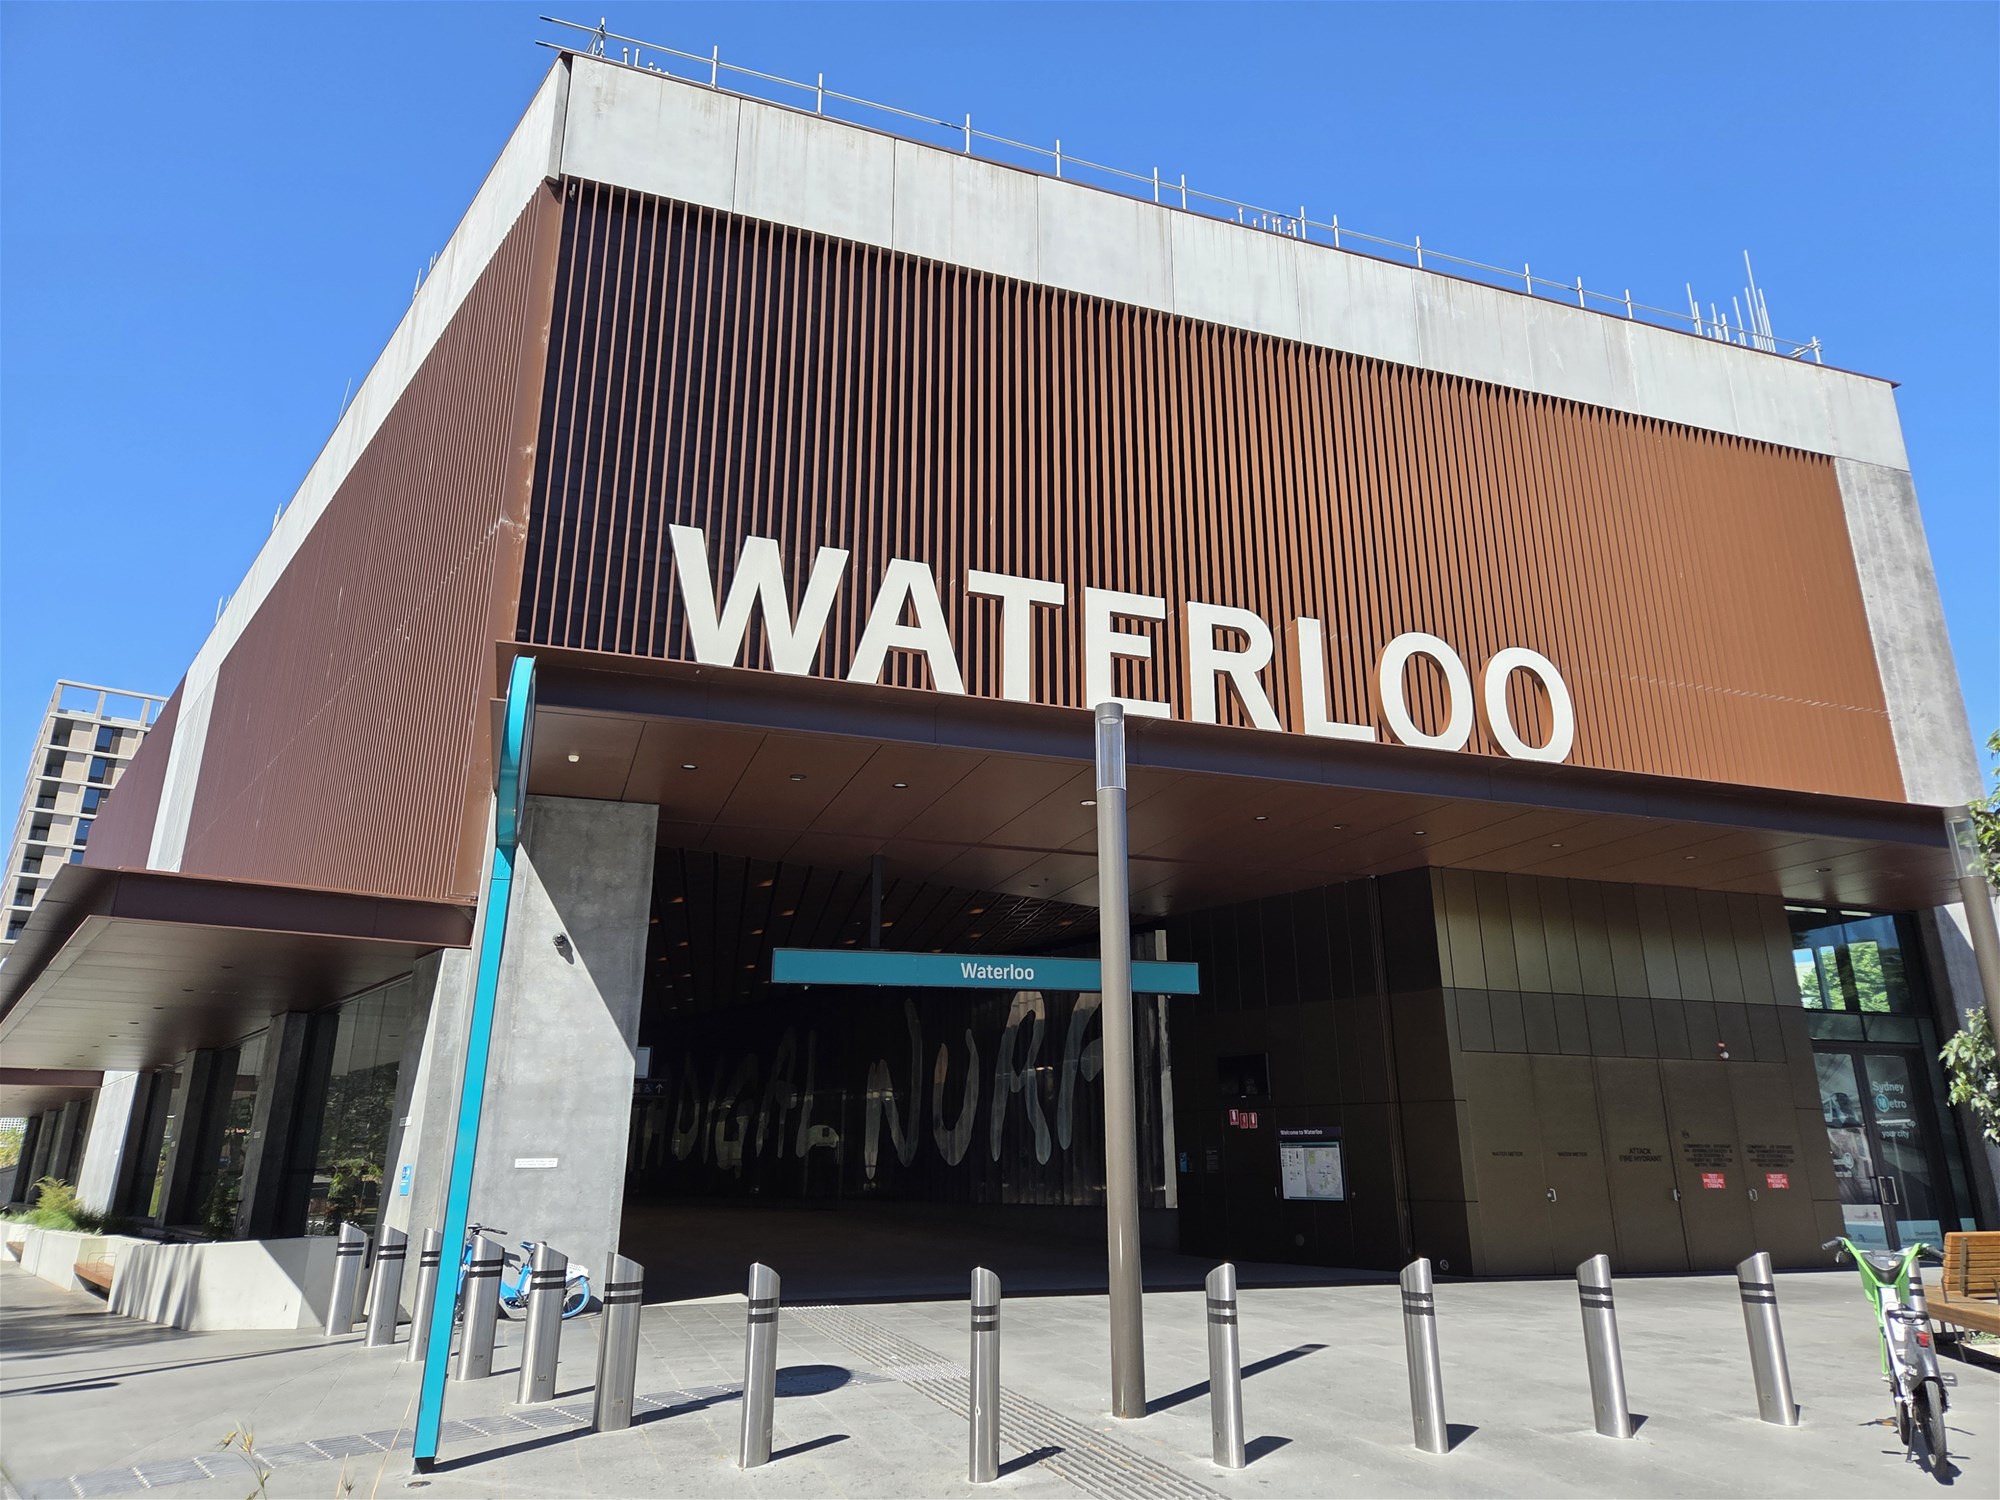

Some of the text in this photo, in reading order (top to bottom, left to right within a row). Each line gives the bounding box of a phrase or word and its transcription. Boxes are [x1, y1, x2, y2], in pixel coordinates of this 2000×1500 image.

[668, 523, 1575, 764] WATERLOO
[960, 962, 1034, 980] Waterloo
[1871, 1081, 1904, 1094] Sydney
[1876, 1094, 1907, 1111] Metro
